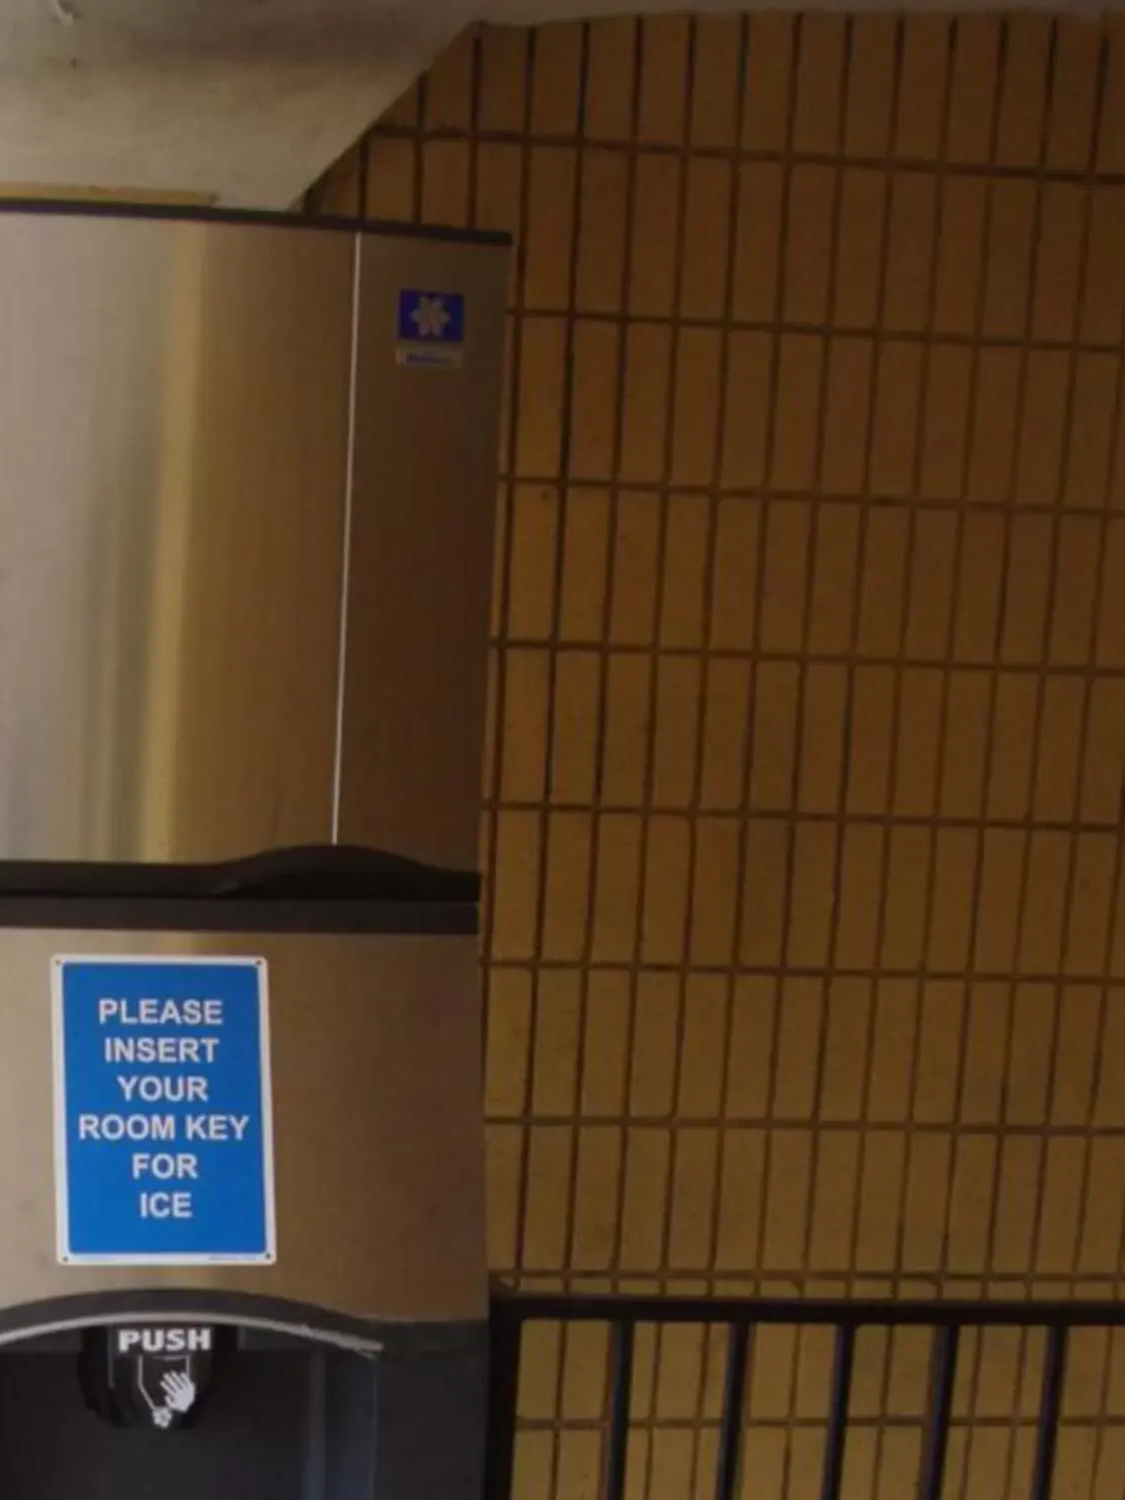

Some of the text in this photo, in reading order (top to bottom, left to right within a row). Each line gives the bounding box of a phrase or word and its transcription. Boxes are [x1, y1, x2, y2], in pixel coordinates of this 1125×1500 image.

[98, 998, 223, 1025] PLEASE
[104, 1037, 220, 1063] INSERT
[117, 1076, 209, 1102] YOUR
[78, 1114, 250, 1141] ROOM KEY
[132, 1153, 199, 1180] FOR
[139, 1192, 193, 1219] ICE
[117, 1328, 212, 1353] PUSH
